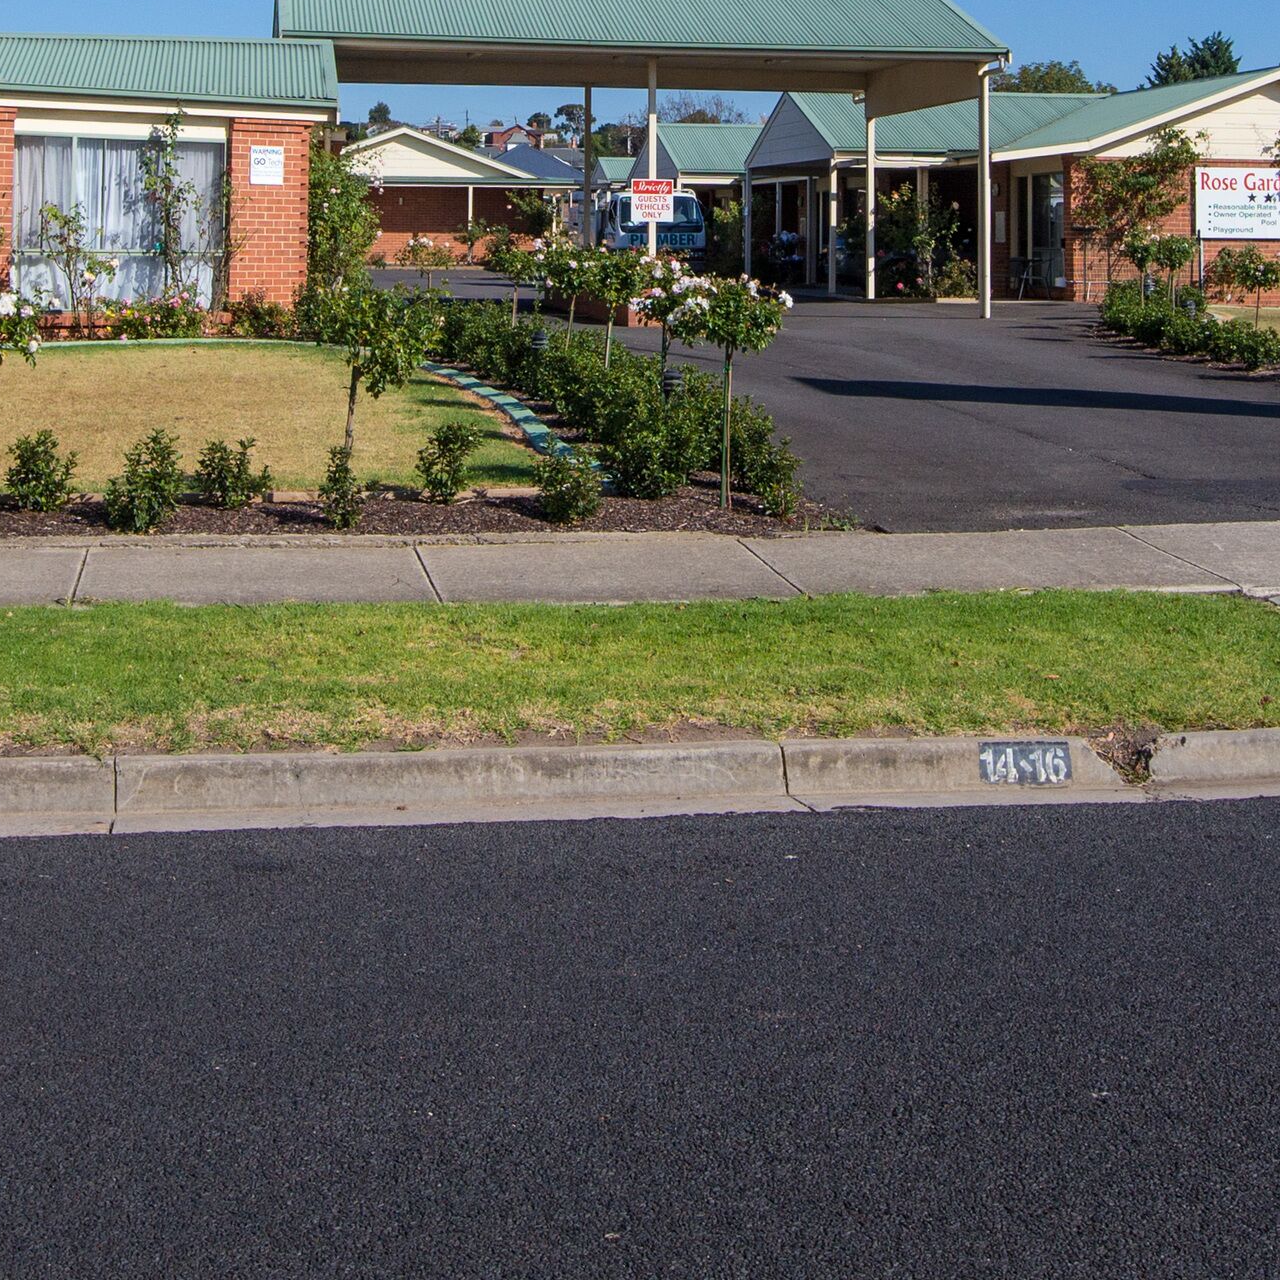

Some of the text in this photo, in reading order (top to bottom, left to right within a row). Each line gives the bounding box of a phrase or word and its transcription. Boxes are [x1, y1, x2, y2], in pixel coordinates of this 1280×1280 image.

[253, 157, 266, 165] GO
[1200, 172, 1238, 190] Rose
[633, 181, 671, 195] Strictly
[1212, 226, 1254, 234] Playground
[630, 233, 696, 246] PLMBER
[980, 747, 1067, 783] 14-16
